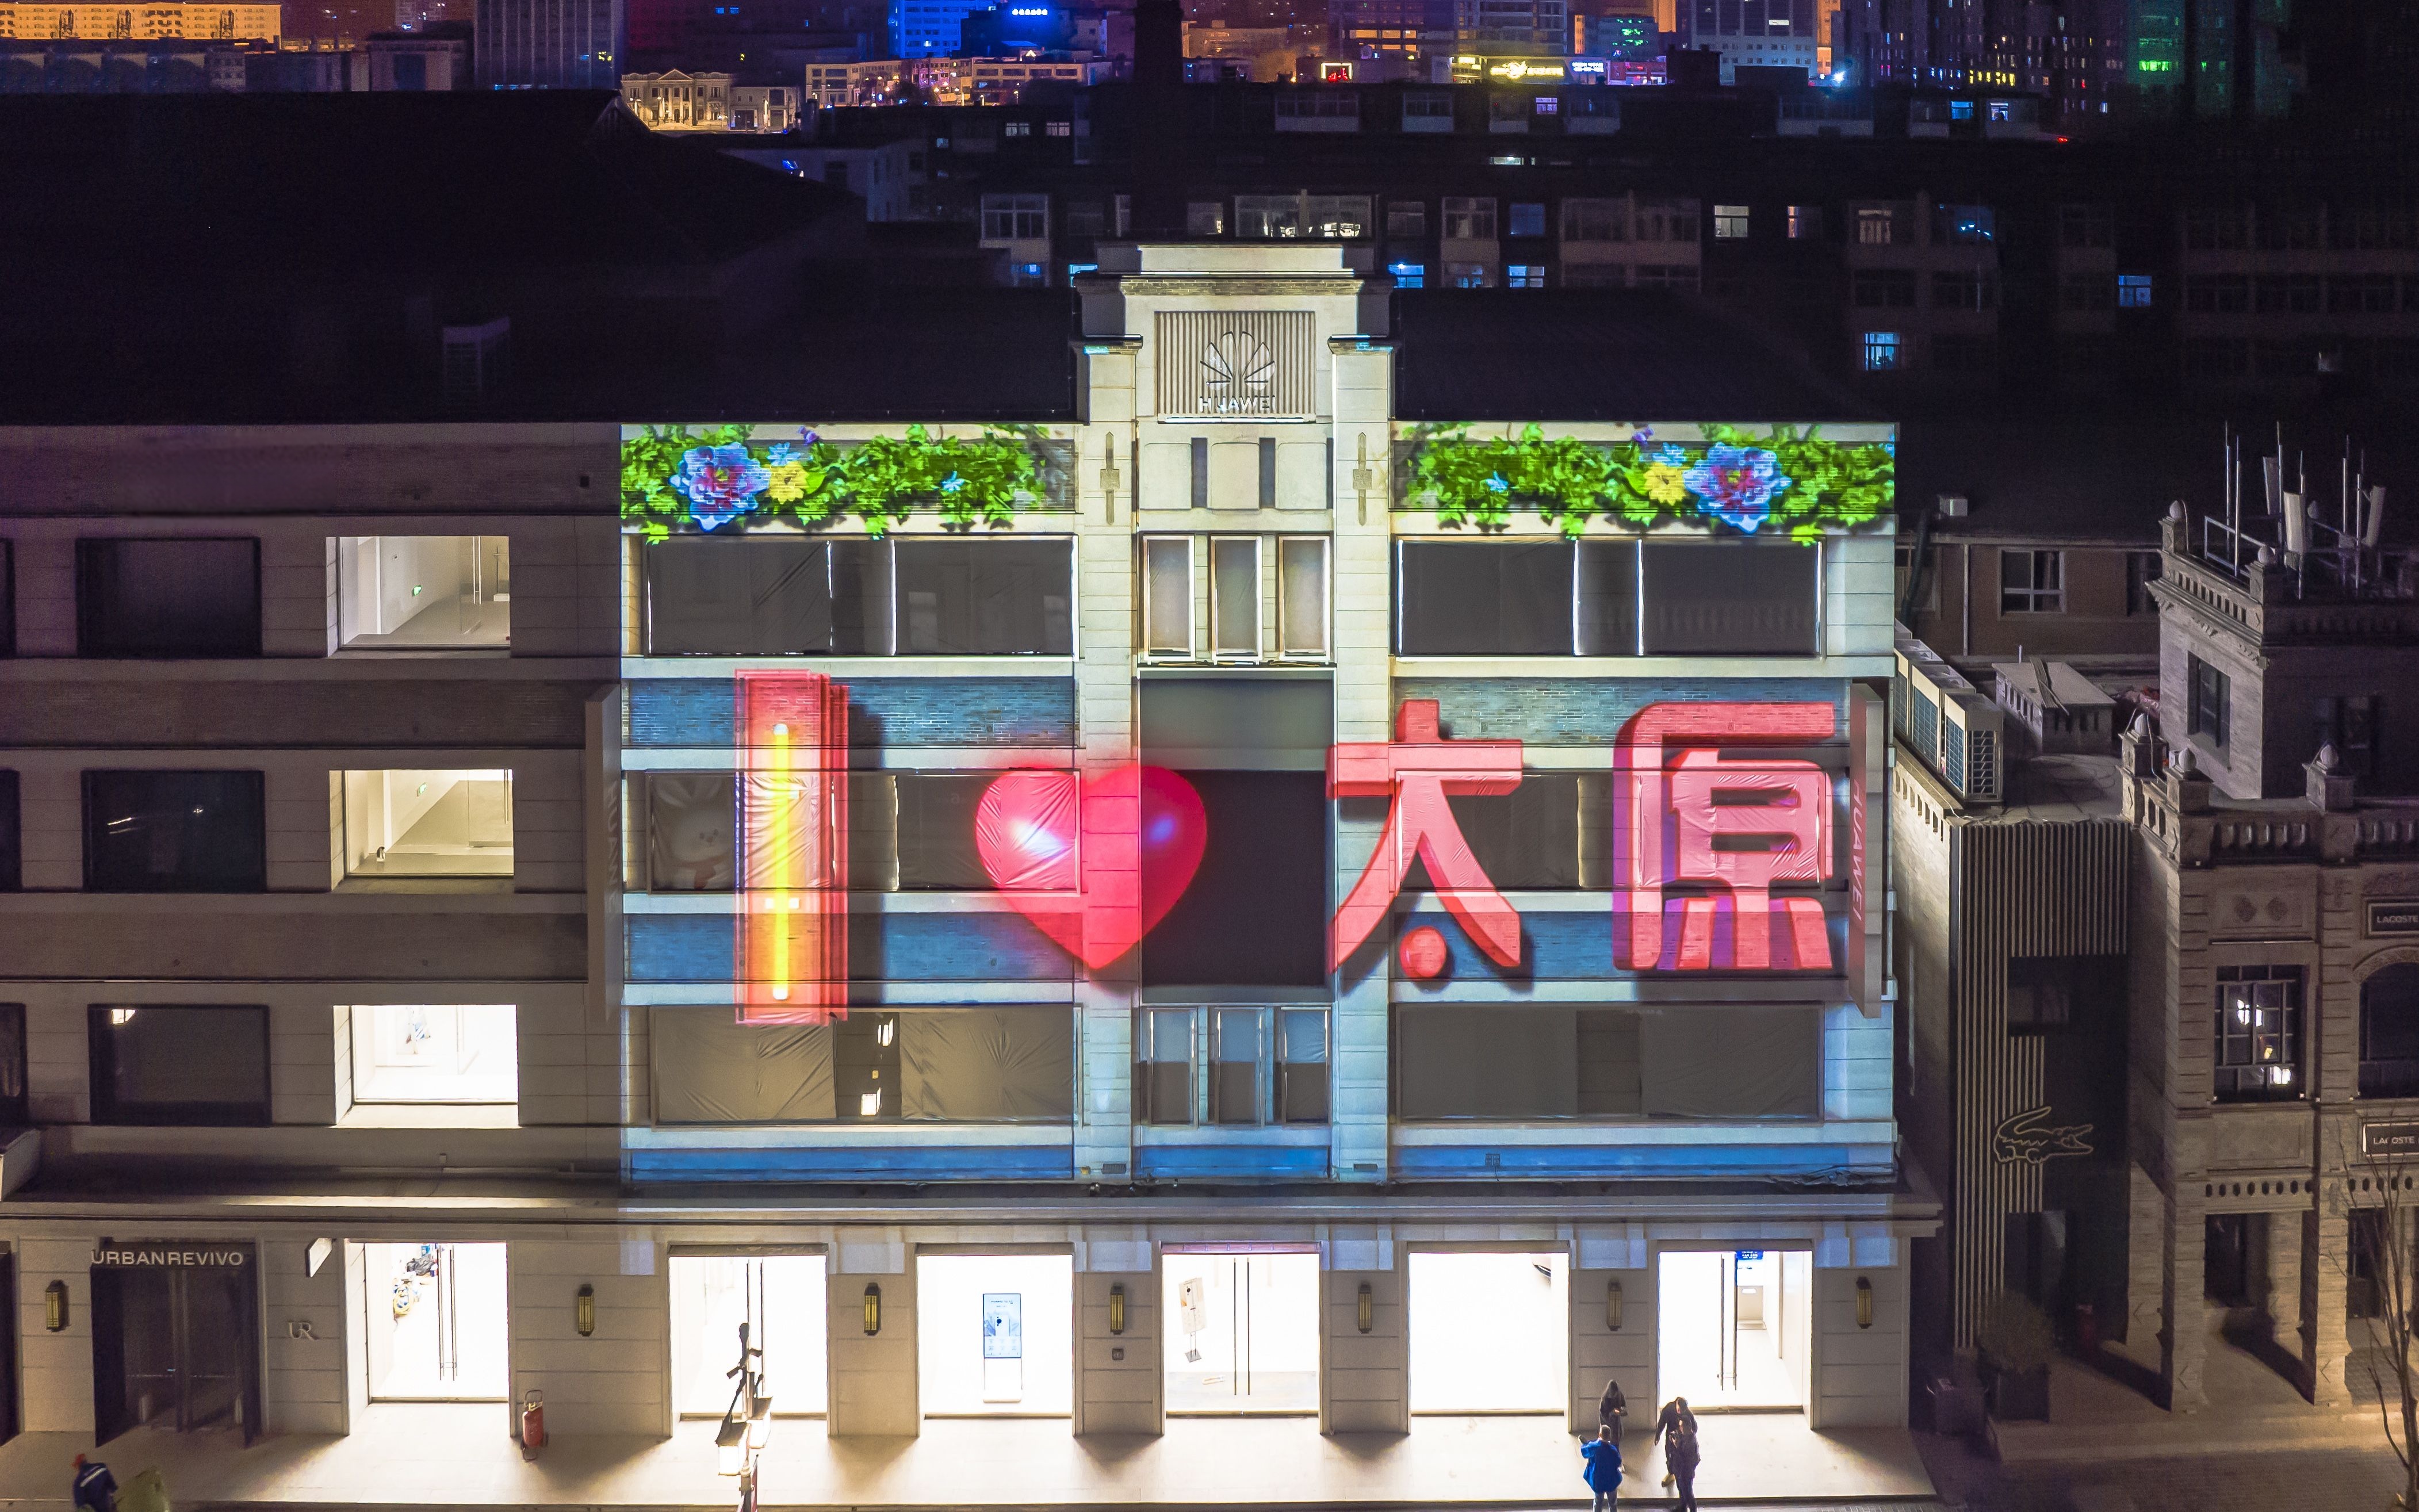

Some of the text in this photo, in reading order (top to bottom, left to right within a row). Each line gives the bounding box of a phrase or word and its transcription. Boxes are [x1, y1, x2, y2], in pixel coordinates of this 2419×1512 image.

[1199, 395, 1276, 413] HUAWEI
[1326, 698, 1835, 979] 太原
[1853, 779, 1862, 921] HUAWEI
[2376, 915, 2418, 923] LACOSTE
